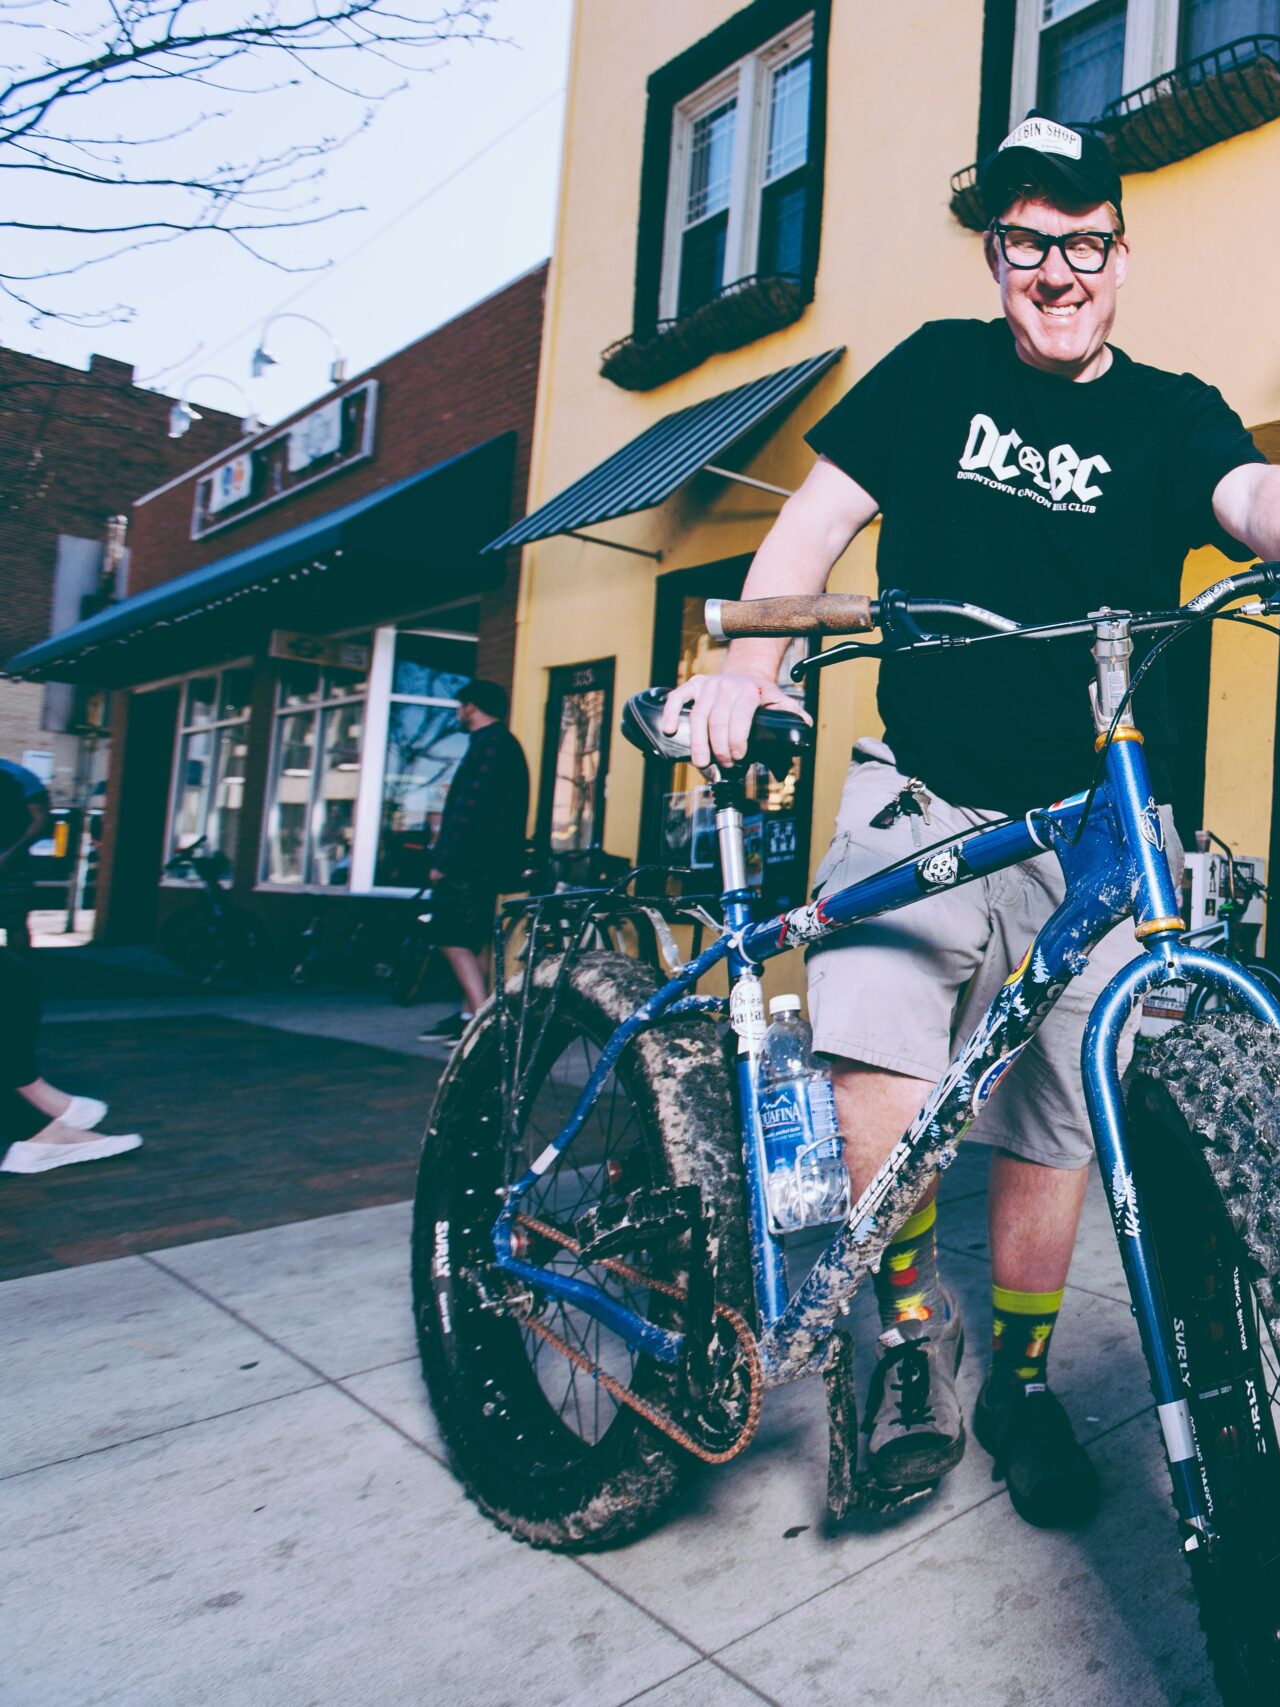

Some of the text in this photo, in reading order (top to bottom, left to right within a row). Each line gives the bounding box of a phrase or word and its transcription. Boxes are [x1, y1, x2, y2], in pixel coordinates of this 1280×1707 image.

[1046, 124, 1077, 144] SHOP
[956, 470, 1016, 496] DOWNTOWN
[1017, 488, 1052, 508] CNTON
[1068, 502, 1097, 514] CLUB
[434, 1220, 452, 1278] SURLY
[1173, 1317, 1192, 1388] SURLY
